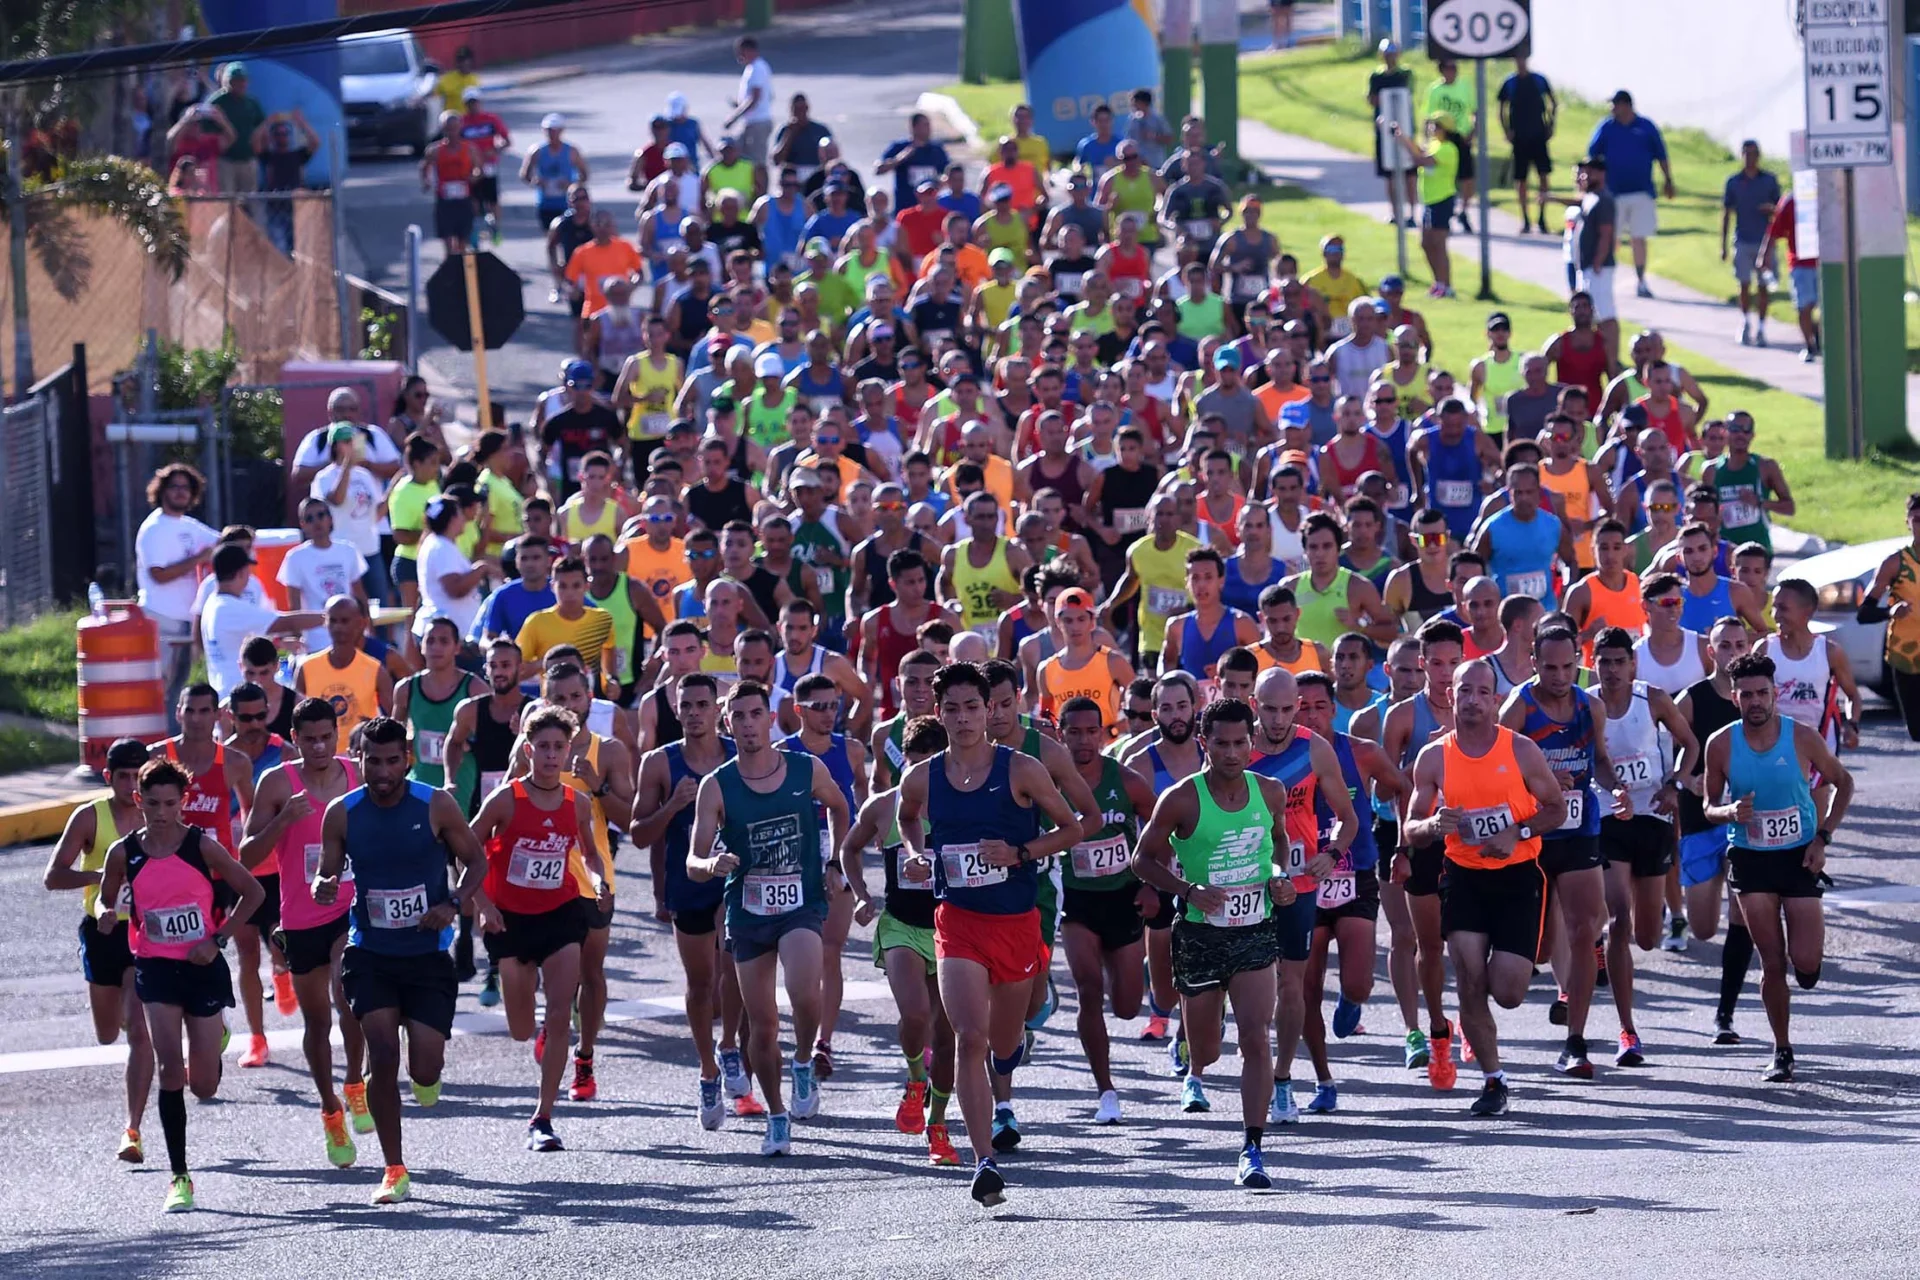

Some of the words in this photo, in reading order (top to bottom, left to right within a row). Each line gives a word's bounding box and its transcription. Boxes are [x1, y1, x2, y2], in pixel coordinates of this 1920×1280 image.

[1443, 12, 1517, 42] 309
[1811, 36, 1881, 54] VELOCIDAD
[1811, 61, 1883, 77] MAXIMA
[1615, 760, 1649, 783] 212
[1475, 812, 1508, 837] 261
[1766, 814, 1799, 838] 325
[1093, 843, 1126, 868] 279
[1208, 862, 1226, 871] new
[1226, 851, 1259, 868] balan
[530, 860, 562, 880] 342
[966, 877, 984, 886] 2017
[765, 883, 799, 906] 359
[1323, 878, 1352, 899] 273
[389, 894, 425, 920] 354
[1229, 890, 1261, 917] 397
[166, 911, 200, 936] 400
